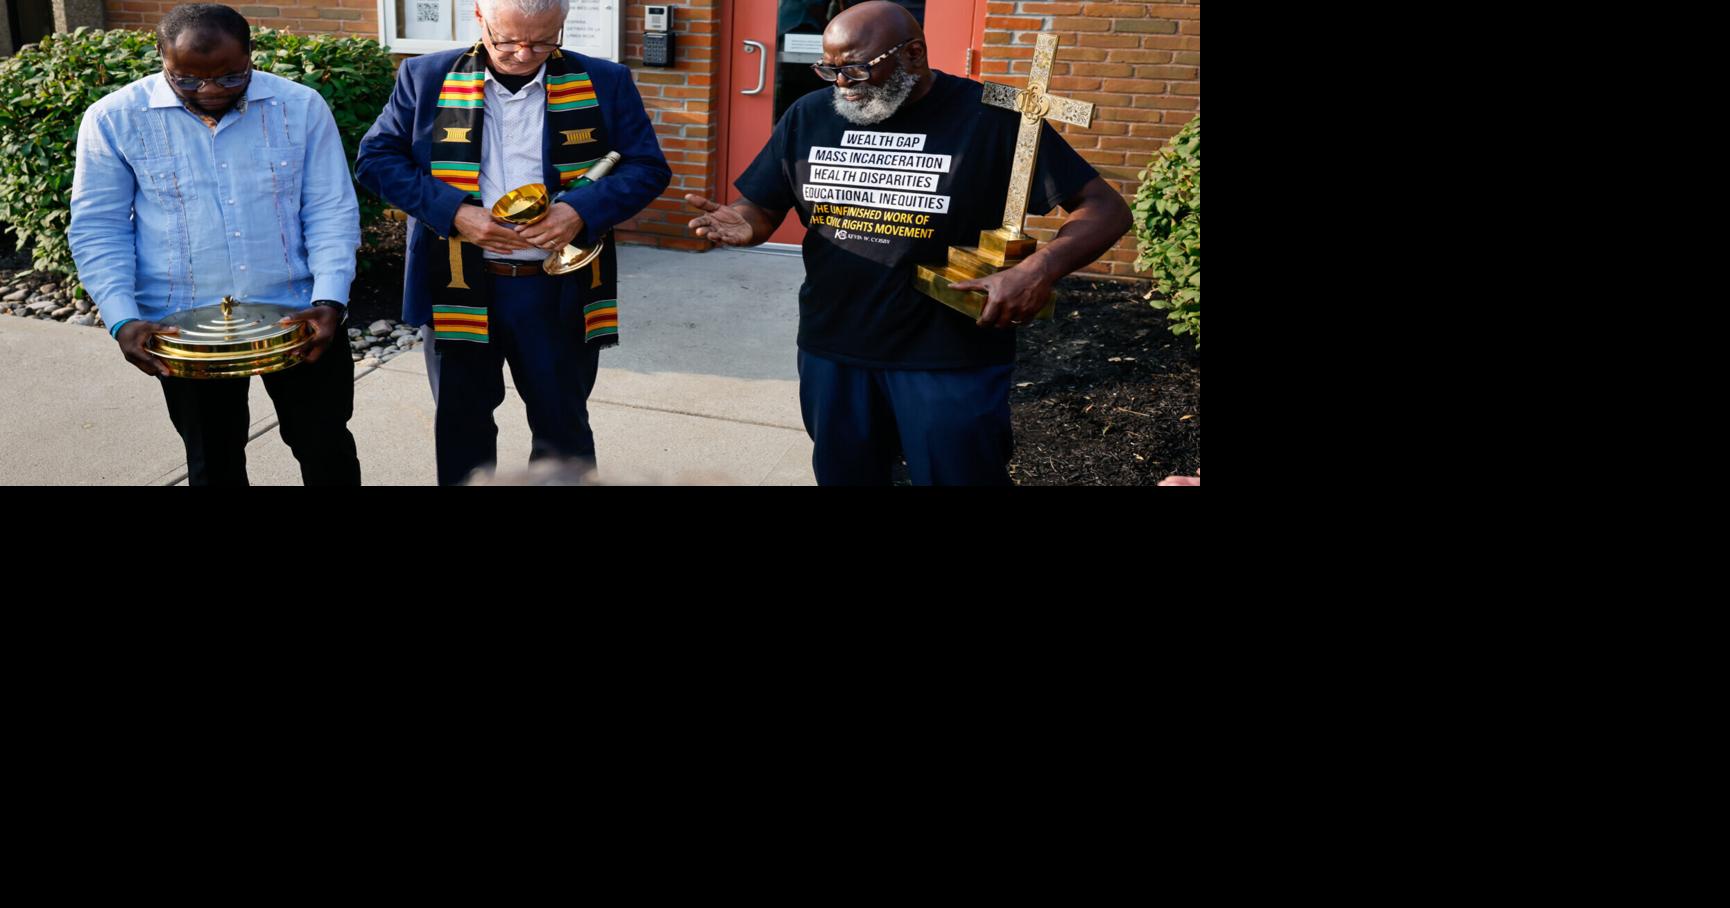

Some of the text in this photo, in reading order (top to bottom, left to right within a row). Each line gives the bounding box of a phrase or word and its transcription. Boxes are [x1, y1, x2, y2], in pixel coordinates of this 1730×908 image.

[847, 134, 920, 148] WEALTH GAP
[815, 150, 943, 169] MASS INCARCERATION
[814, 168, 932, 188] HEALTH DISPARITIES
[804, 186, 944, 210] EDUCATIONAL INEQUITIES
[830, 205, 882, 220] UNFINISHED
[883, 210, 912, 224] WORK
[915, 214, 930, 226] OF
[842, 219, 873, 232] RIGHTS
[874, 224, 935, 239] MOVEMENT
